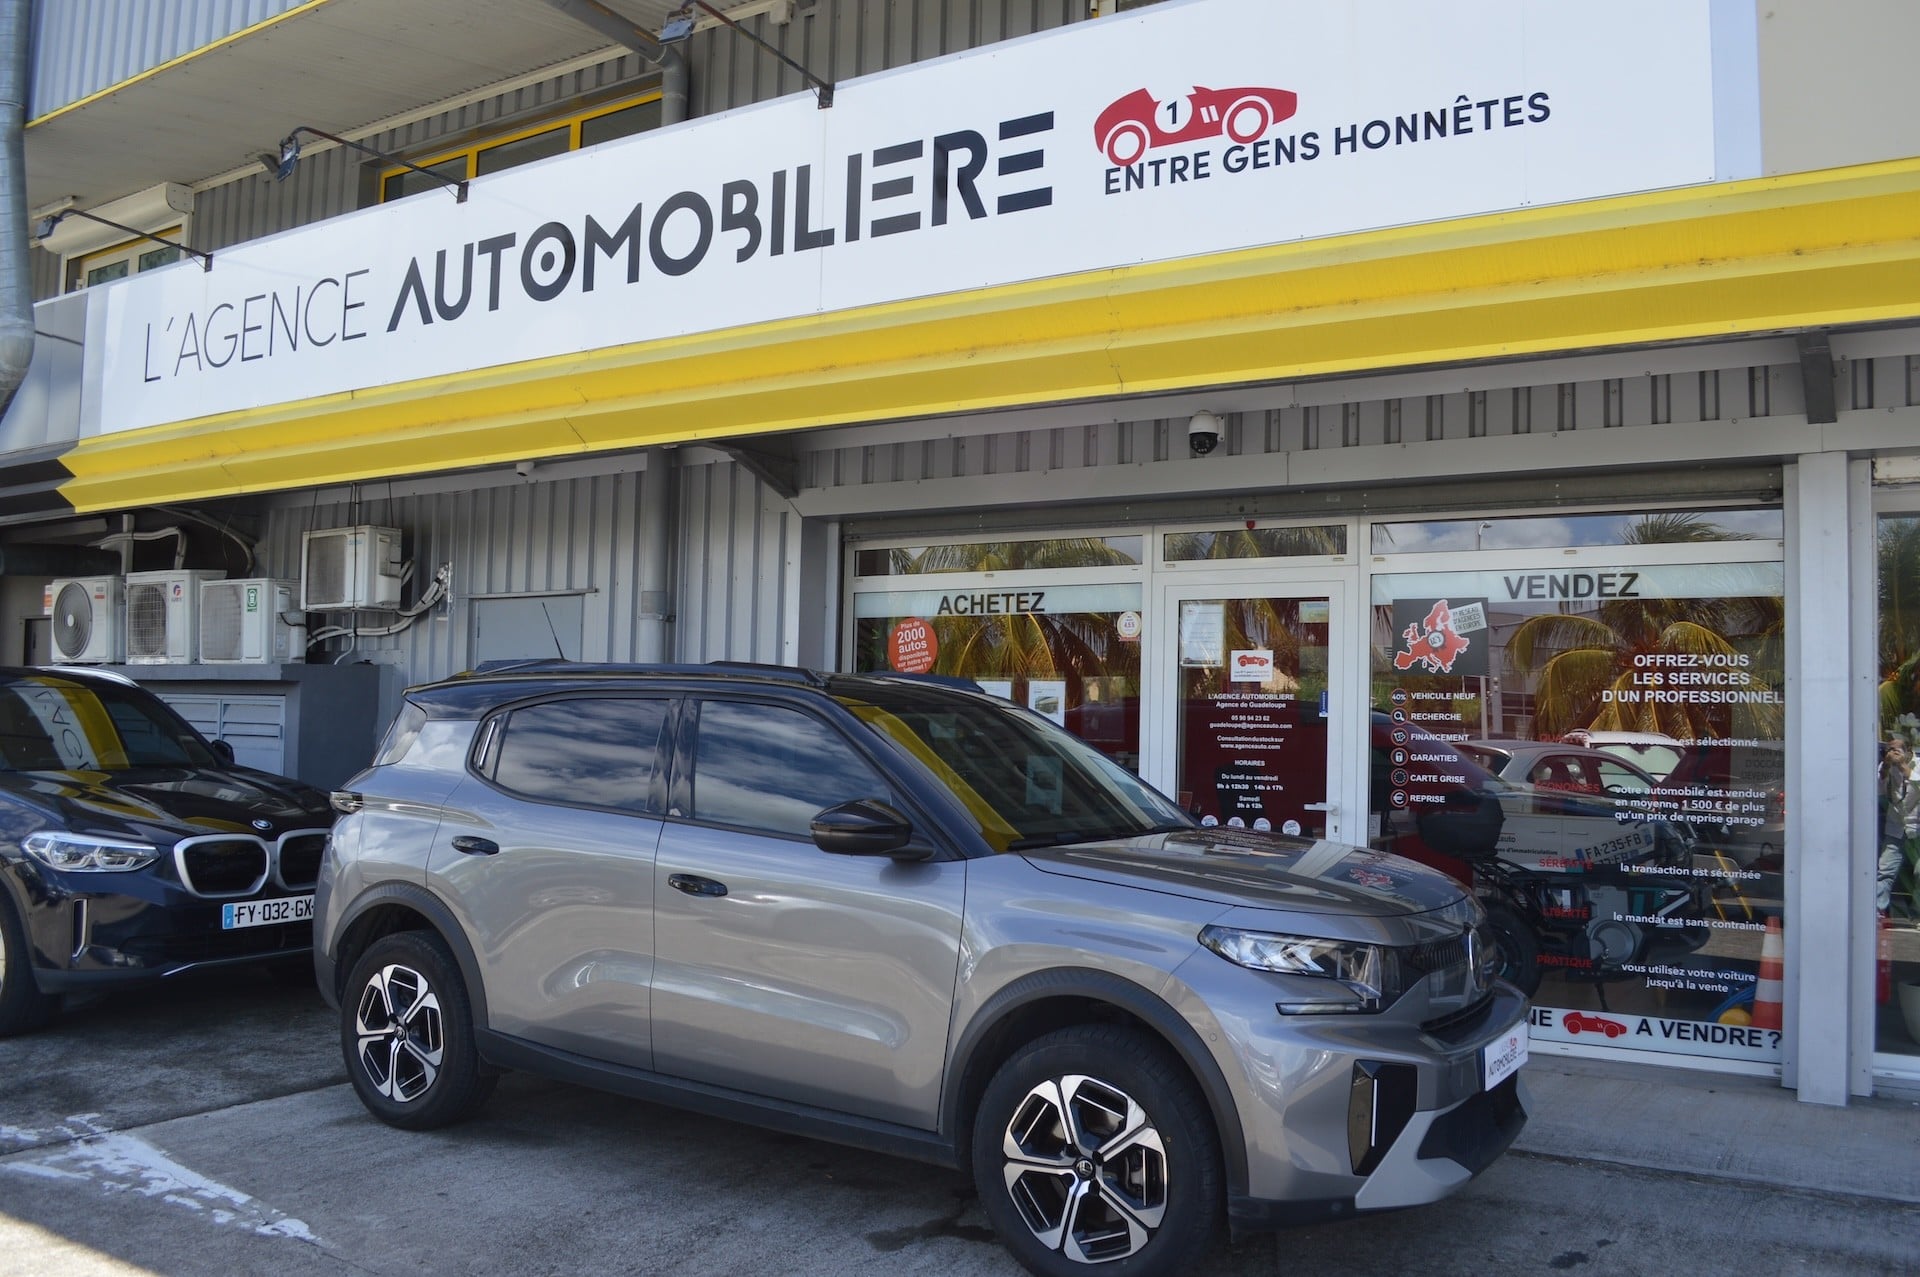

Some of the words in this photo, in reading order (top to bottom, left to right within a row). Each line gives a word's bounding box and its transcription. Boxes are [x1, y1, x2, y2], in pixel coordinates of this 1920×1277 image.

[1166, 101, 1178, 125] 1
[1104, 151, 1211, 195] ENTRE
[1222, 131, 1320, 173] GENS
[1334, 92, 1551, 156] HONNÊTES
[144, 269, 370, 382] L'AGENCE
[387, 111, 1054, 332] AUTOMOBILIERE
[1503, 573, 1640, 599] VENDEZ
[937, 592, 1045, 615] ACHETEZ
[897, 626, 926, 644] 2000
[898, 640, 927, 654] autos
[1633, 654, 1749, 667] OFFREZ-VOUS
[1633, 672, 1664, 685] LES
[1668, 672, 1751, 685] SERVICES
[1601, 690, 1641, 703] D'UN
[1645, 691, 1784, 704] PROFESSIONNEL
[1411, 713, 1462, 721] RECHERCHE
[1411, 733, 1469, 741] FINANCEMENT
[1696, 736, 1759, 748] sélectionné
[1410, 774, 1438, 782] CARTE
[1440, 775, 1466, 783] GRISE
[1410, 794, 1446, 803] REPRISE
[1614, 785, 1641, 795] votre
[1644, 785, 1704, 796] automobile
[1707, 788, 1724, 797] est
[1725, 788, 1766, 799] vendue
[1615, 799, 1627, 807] en
[1630, 799, 1679, 811] moyenne
[1715, 801, 1725, 810] €
[1727, 801, 1740, 811] de
[1742, 802, 1765, 814] plus
[1614, 811, 1644, 821] qu'un
[1647, 811, 1667, 823] prix
[1669, 812, 1684, 822] de
[1686, 813, 1723, 825] reprise
[1726, 816, 1765, 827] garage
[1620, 863, 1630, 872] la
[1632, 864, 1690, 876] transaction
[1692, 867, 1708, 877] est
[1710, 868, 1761, 880] sécurisée
[1613, 912, 1623, 922] le
[1625, 913, 1665, 925] mandat
[1667, 917, 1683, 926] est
[1685, 918, 1709, 928] sans
[1711, 919, 1767, 932] contrainte
[1621, 963, 1646, 974] vous
[1648, 963, 1685, 977] utilisez
[1687, 967, 1715, 980] votre
[1717, 968, 1756, 982] voiture
[1645, 976, 1684, 990] jusqu'à
[1686, 979, 1696, 991] la
[1698, 981, 1729, 993] vente
[1636, 1018, 1653, 1036] A
[1659, 1020, 1763, 1048] VENDRE
